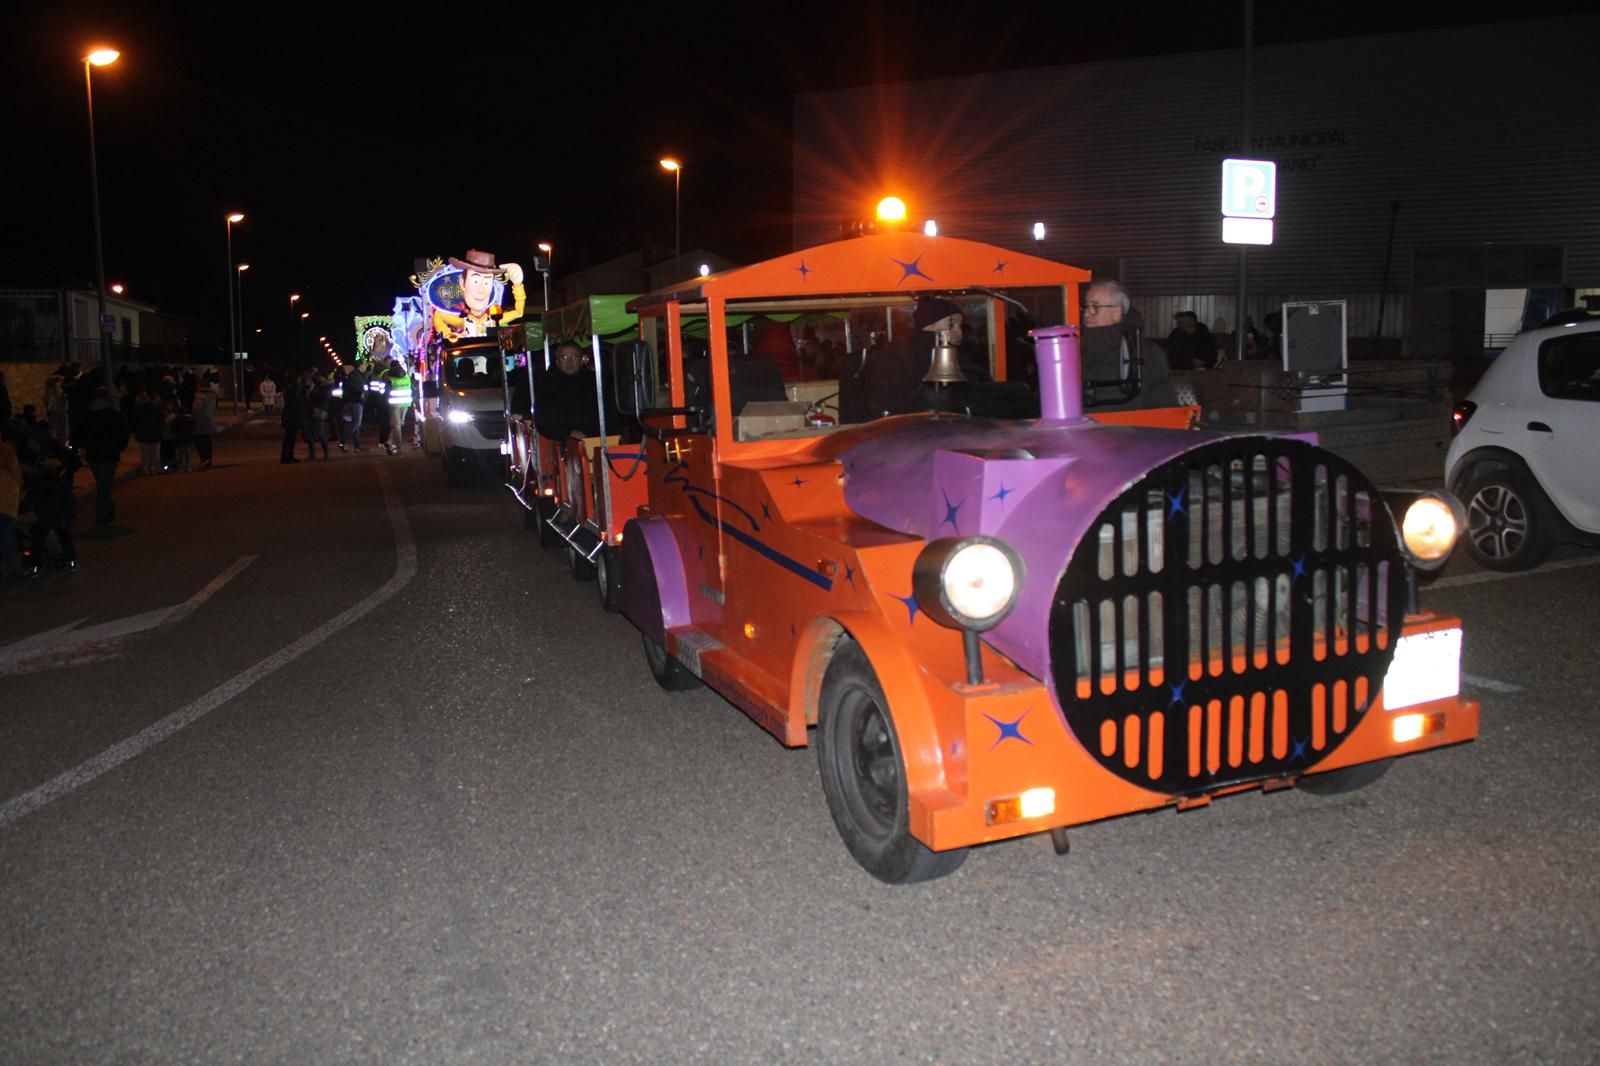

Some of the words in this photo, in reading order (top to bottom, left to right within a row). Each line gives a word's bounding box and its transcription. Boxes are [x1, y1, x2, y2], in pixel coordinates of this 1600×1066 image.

[1194, 135, 1263, 153] PABELLN
[1267, 128, 1346, 149] MUNICIPAL
[1233, 166, 1265, 209] P
